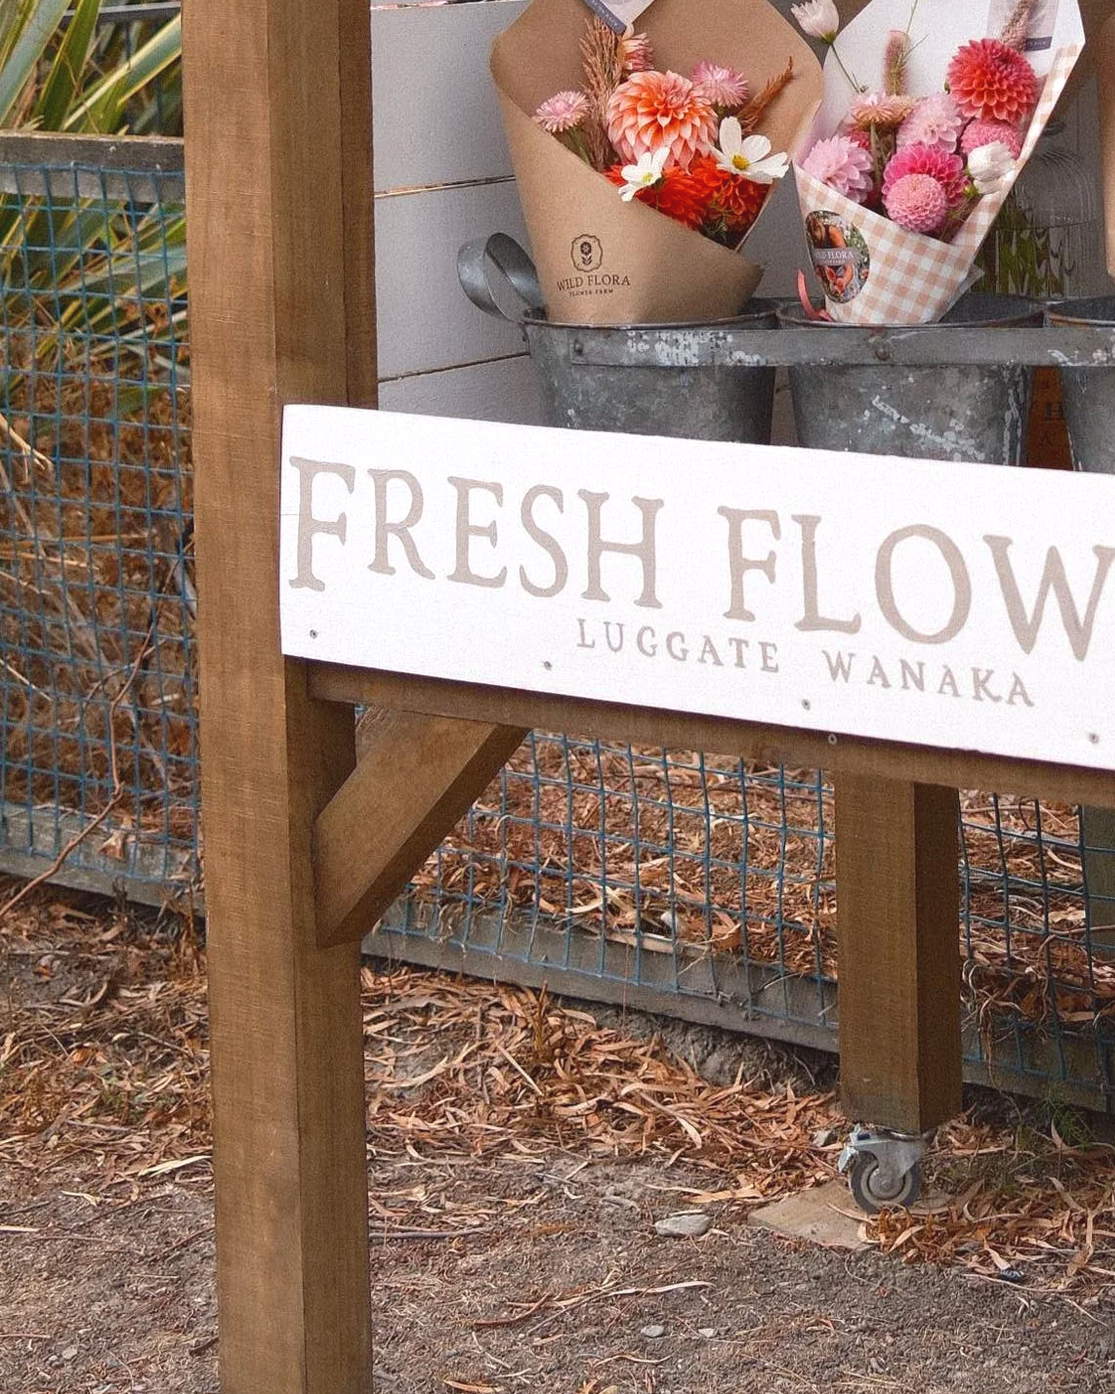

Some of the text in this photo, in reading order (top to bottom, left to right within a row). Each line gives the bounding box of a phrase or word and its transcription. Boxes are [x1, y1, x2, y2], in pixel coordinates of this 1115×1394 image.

[556, 273, 631, 291] WILD FLORA
[288, 454, 663, 609] FRESH
[577, 617, 1036, 708] LUGGATE WANAKA
